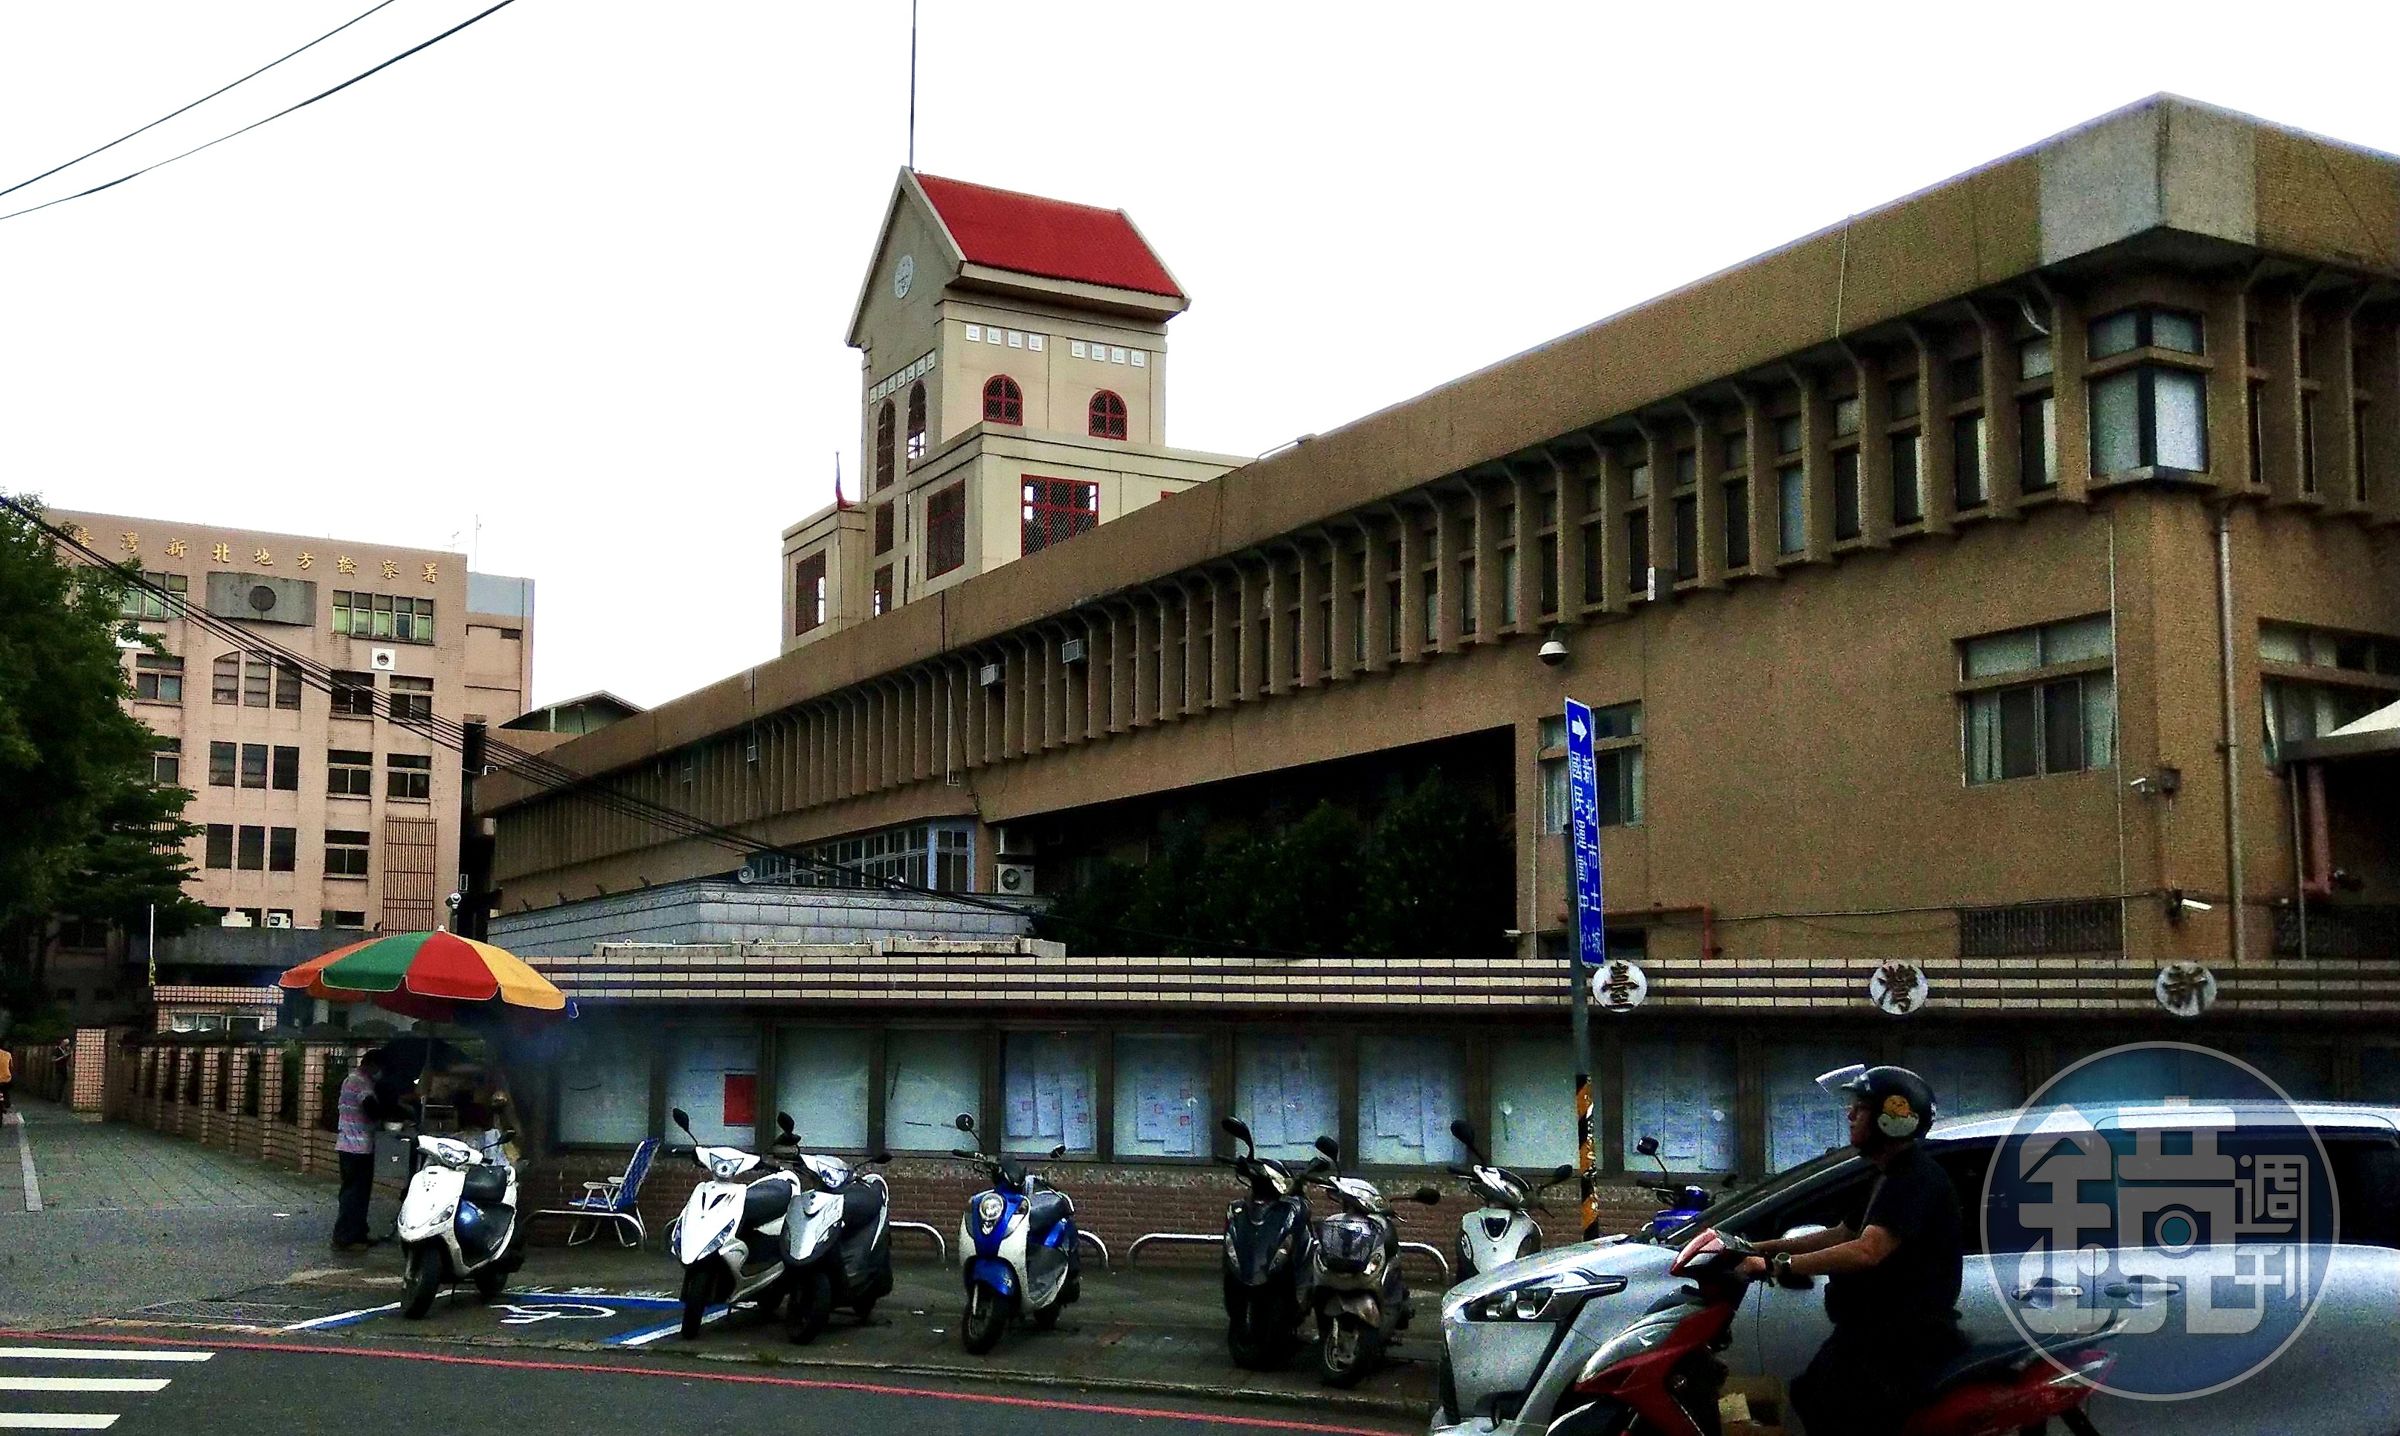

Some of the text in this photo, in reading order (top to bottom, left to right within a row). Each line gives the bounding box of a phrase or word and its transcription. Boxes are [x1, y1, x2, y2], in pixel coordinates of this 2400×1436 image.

[75, 527, 438, 584] 臺灣新北地方檢察署
[1602, 959, 1638, 1011] 臺
[2166, 965, 2208, 1010] 新
